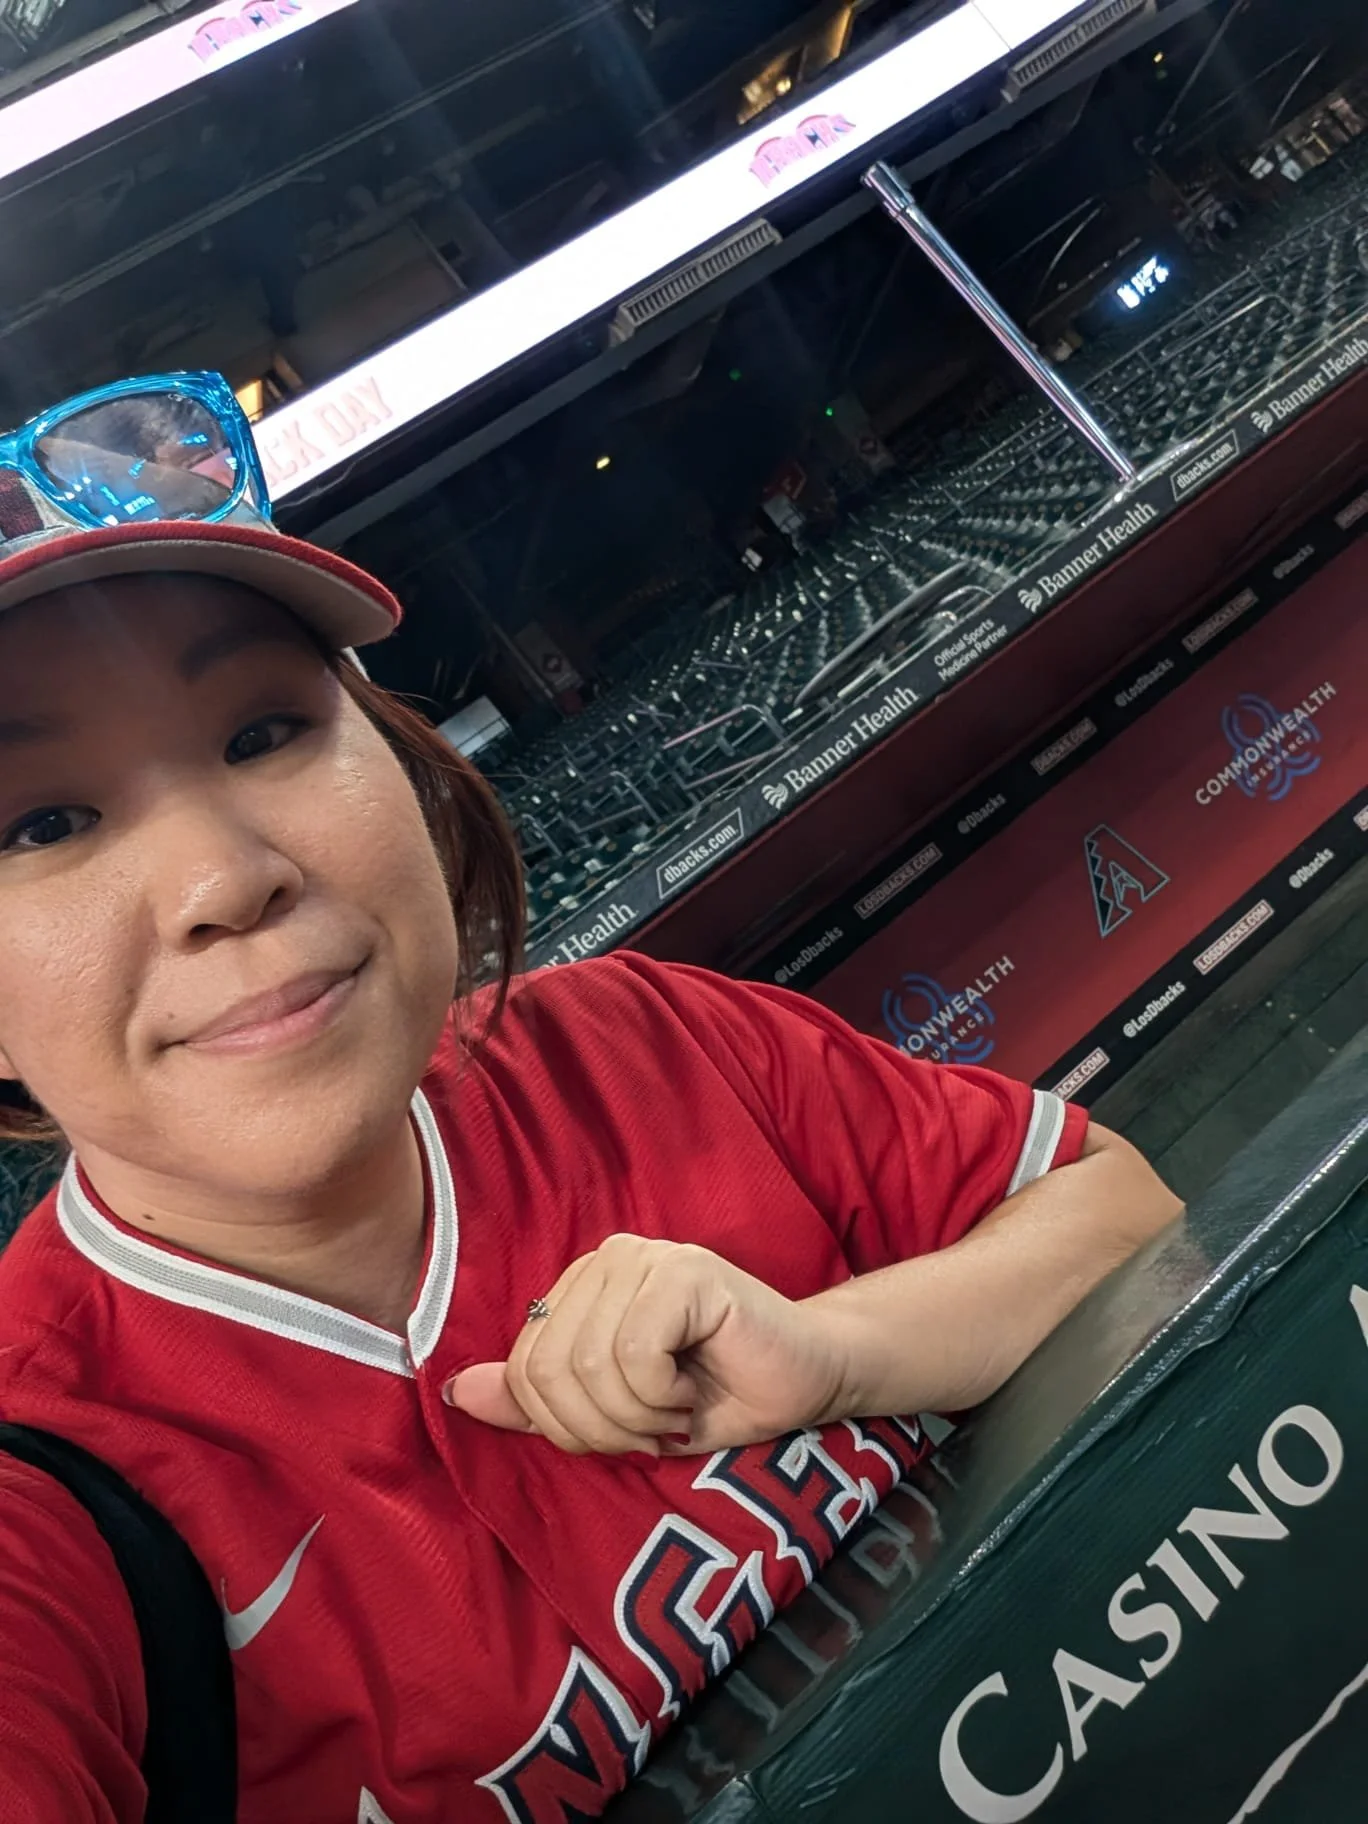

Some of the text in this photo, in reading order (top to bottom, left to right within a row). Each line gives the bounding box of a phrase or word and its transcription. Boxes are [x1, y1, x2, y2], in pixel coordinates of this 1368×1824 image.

[1267, 375, 1327, 420] Banner
[264, 376, 393, 488] CK DAY
[1176, 441, 1234, 489] dbacks.com
[1036, 502, 1158, 598] Banner Health
[934, 619, 995, 667] Official Sports
[938, 624, 1008, 681] Medicine Partner
[783, 686, 919, 793] Banner Health
[1195, 681, 1337, 805] COMMONWEALTH
[957, 793, 1007, 834] @Dbacks
[663, 823, 738, 884] dbacks.com
[858, 846, 938, 914] LOSDBACKS.COM
[1288, 848, 1335, 889] @Dbacks
[557, 903, 637, 964] Health
[774, 926, 844, 983] @LosDbacks
[1197, 903, 1269, 970] LOSDBACKS.COM
[924, 1011, 985, 1061] URANCE
[1123, 981, 1186, 1038] @LosDbacks
[1052, 1052, 1105, 1099] ACKS.COM
